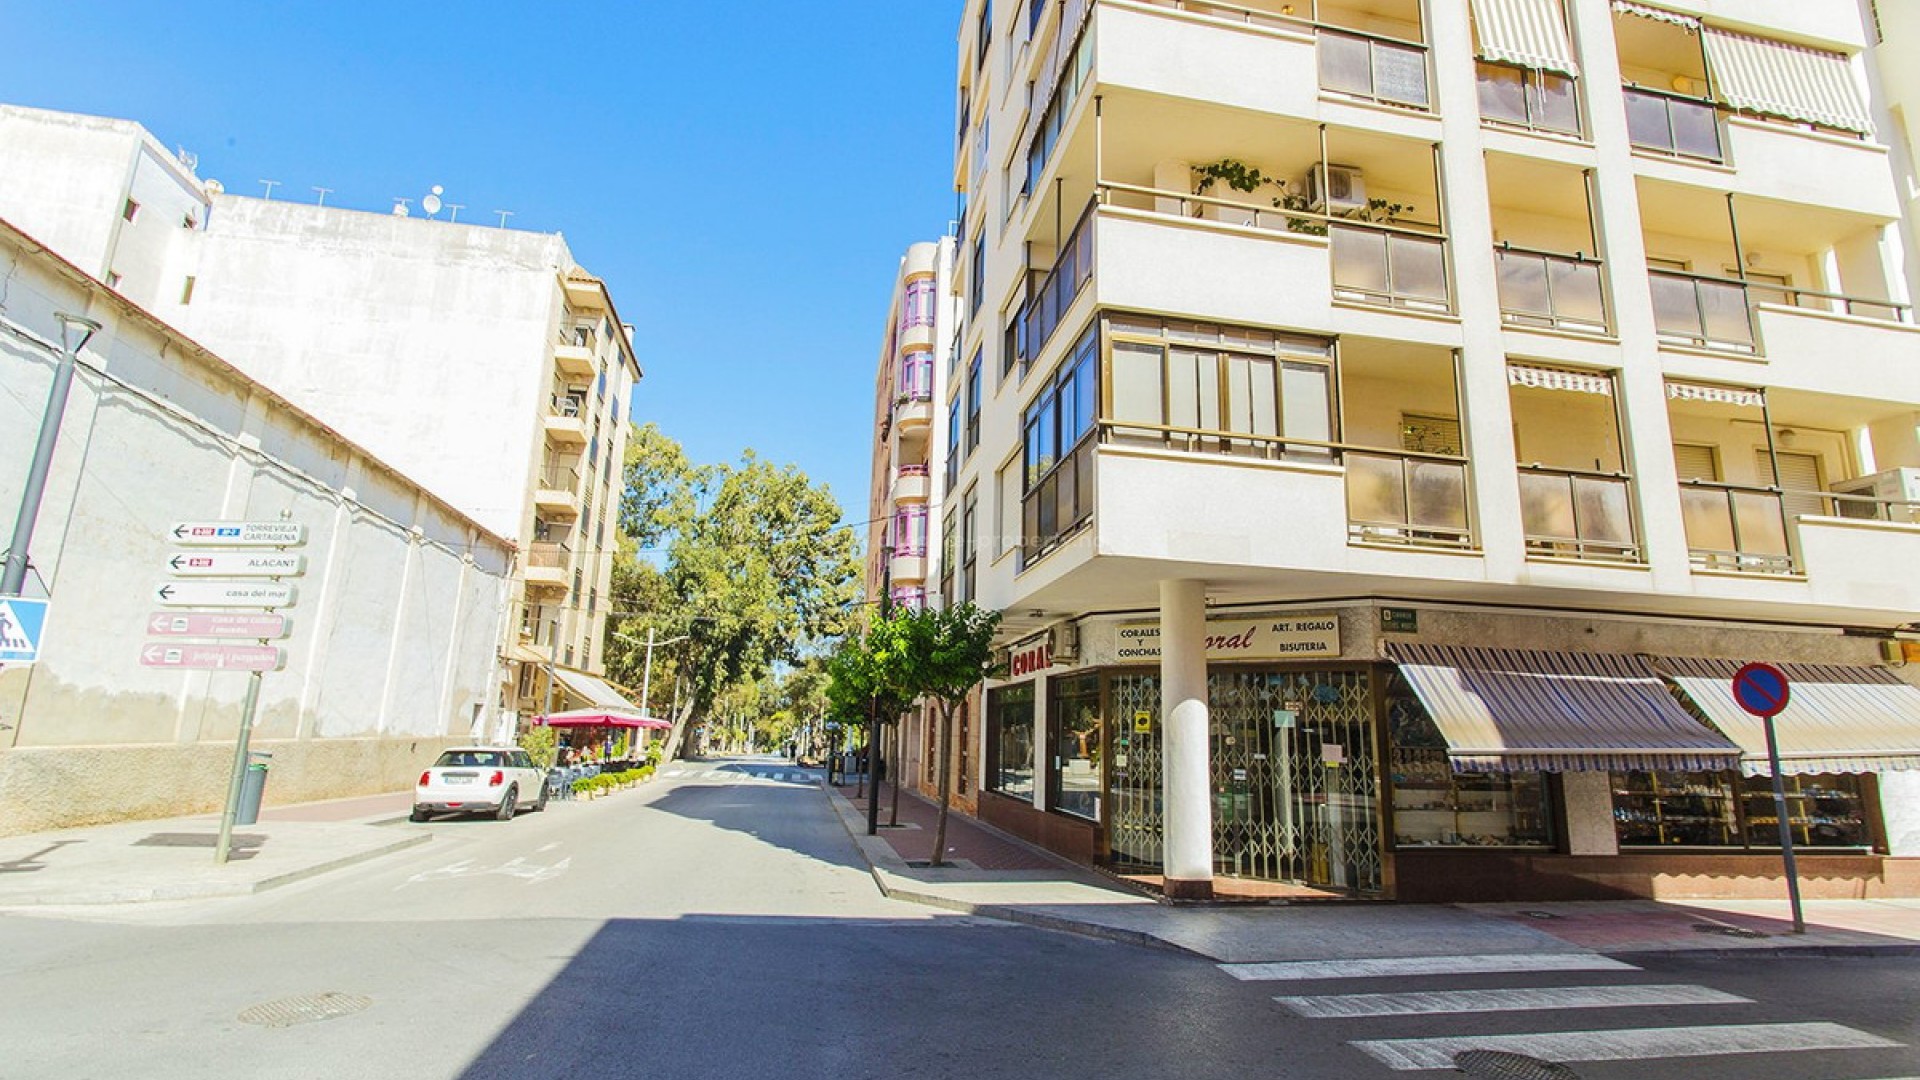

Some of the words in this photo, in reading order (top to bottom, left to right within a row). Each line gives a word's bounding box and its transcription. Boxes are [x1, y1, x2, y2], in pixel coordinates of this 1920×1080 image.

[245, 524, 298, 533] TORREVIEJA
[243, 533, 297, 541] CARTAGENA
[251, 588, 266, 597] del
[269, 590, 287, 598] mar
[1120, 628, 1160, 638] CORALES
[1205, 625, 1256, 649] oral
[1272, 622, 1293, 632] ART.
[1296, 621, 1334, 631] REGALO
[1137, 638, 1144, 646] Y
[1280, 642, 1326, 652] BISUTERIA
